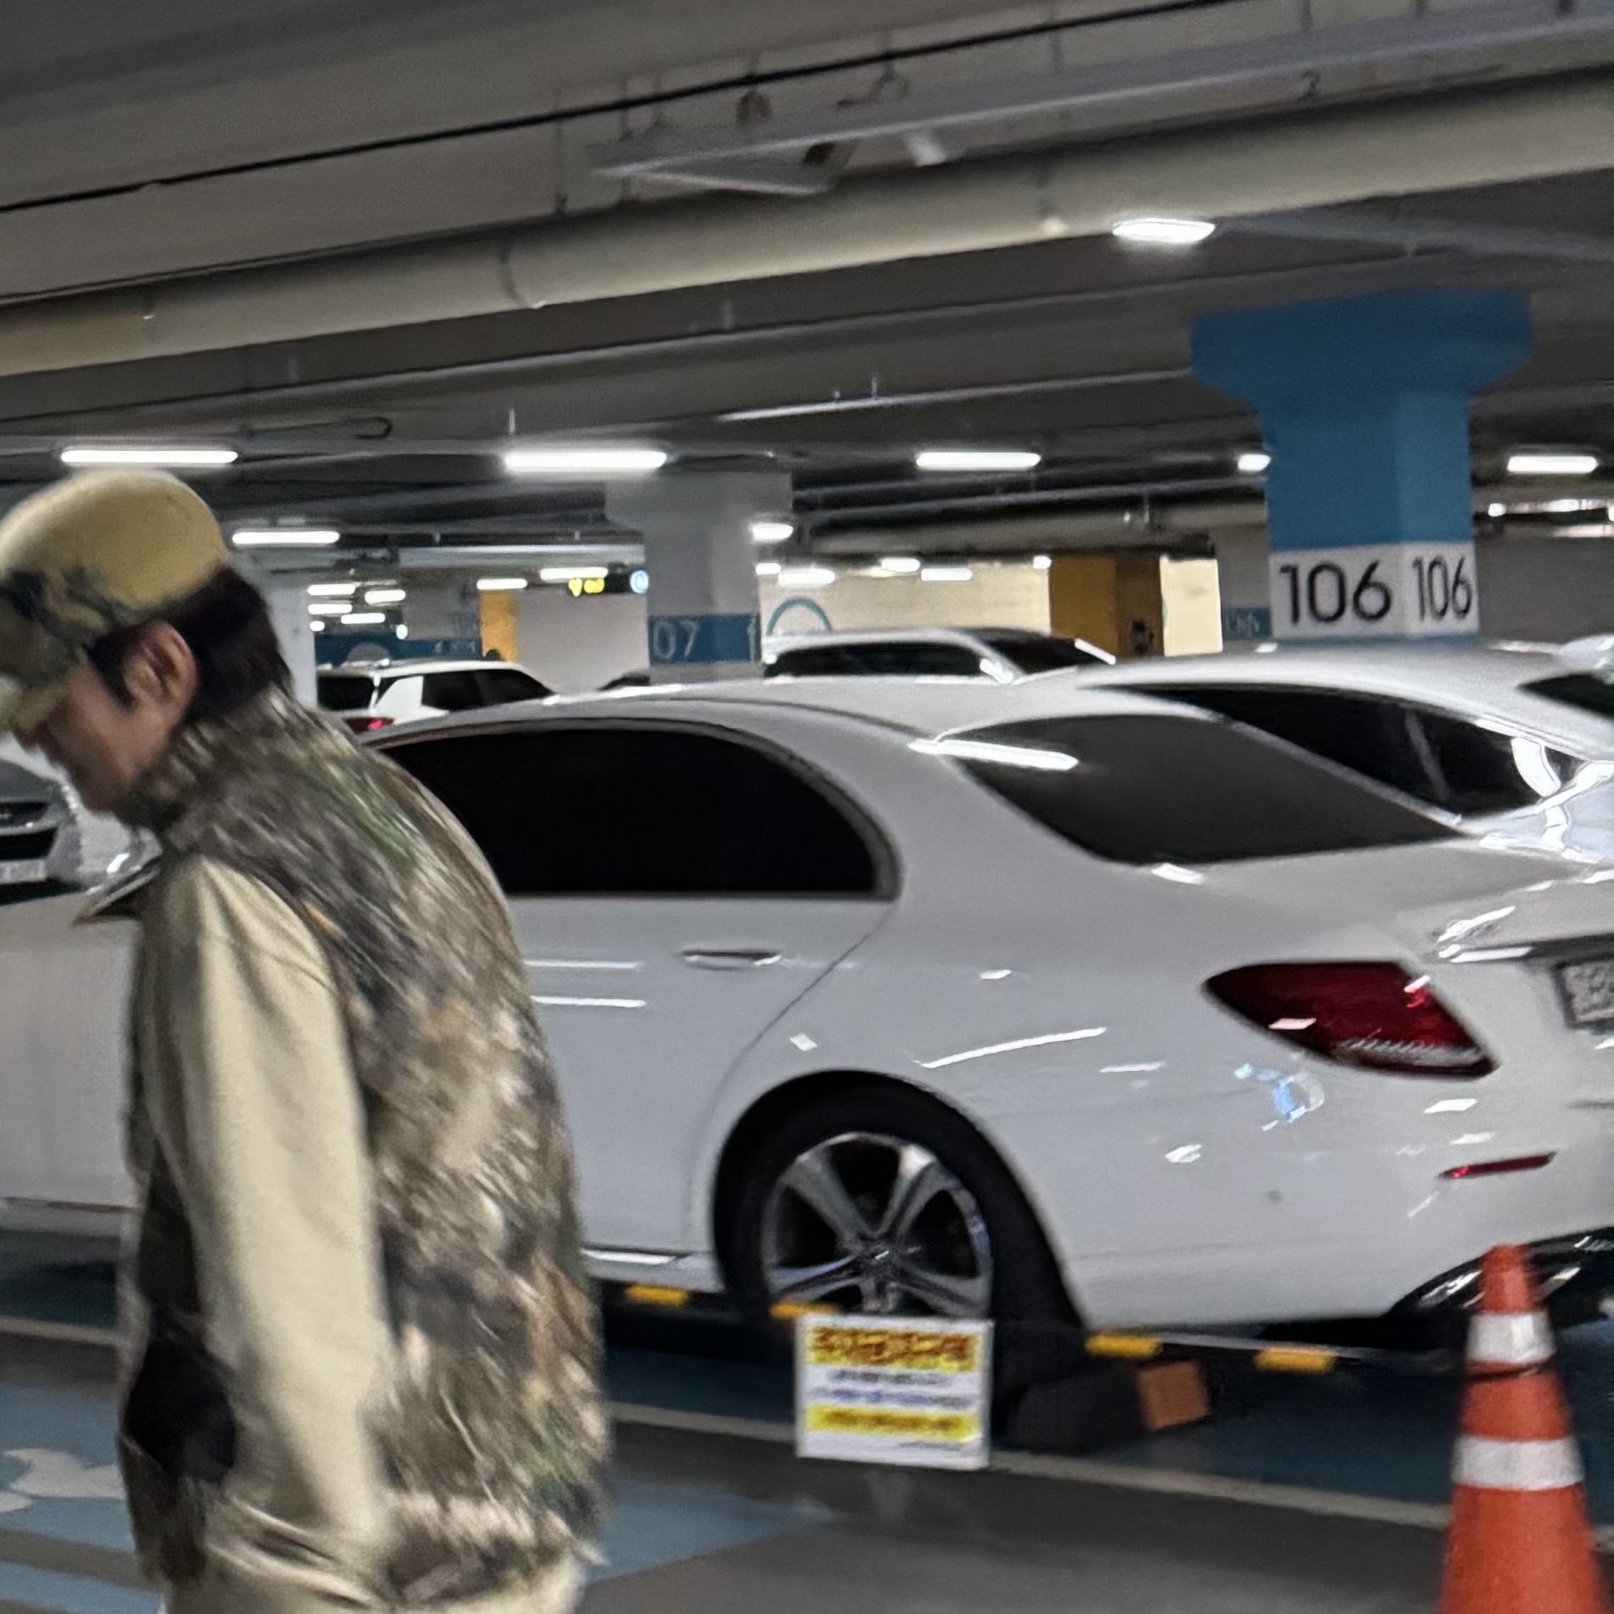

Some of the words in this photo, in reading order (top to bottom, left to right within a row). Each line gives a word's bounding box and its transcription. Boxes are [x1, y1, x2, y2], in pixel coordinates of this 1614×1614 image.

[1279, 560, 1392, 625] 106
[1412, 555, 1473, 622] 106
[652, 618, 701, 660] 07
